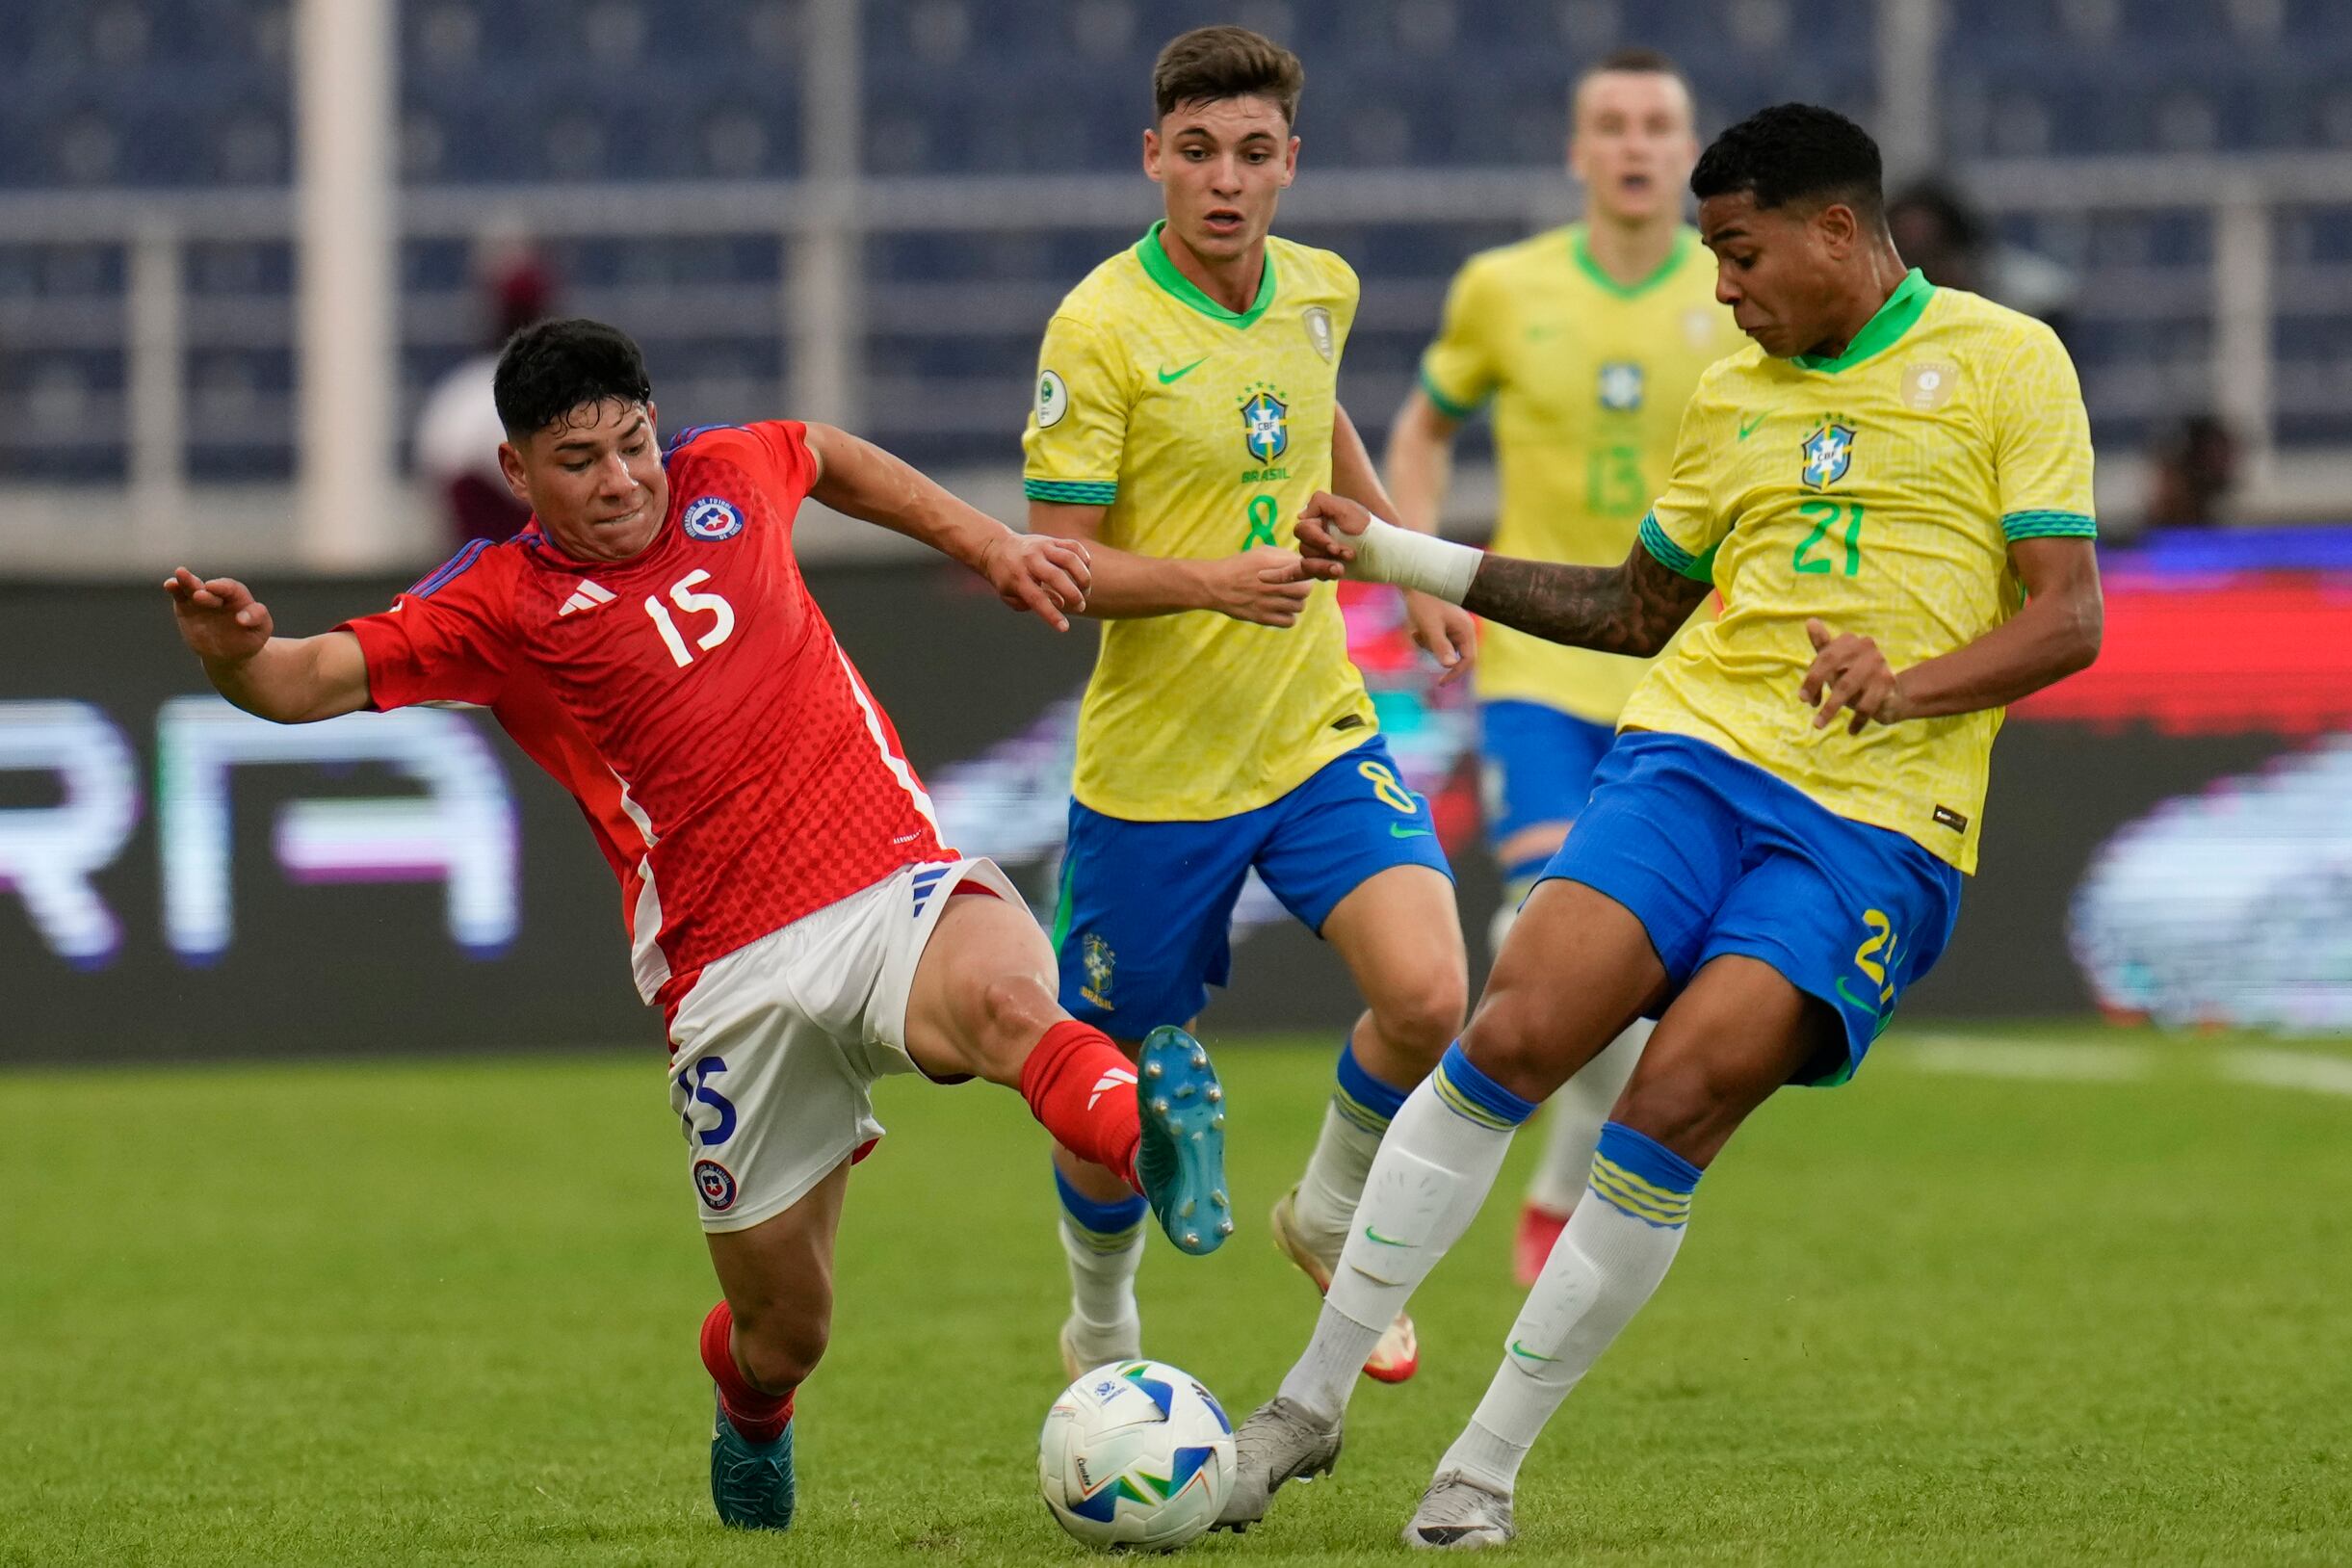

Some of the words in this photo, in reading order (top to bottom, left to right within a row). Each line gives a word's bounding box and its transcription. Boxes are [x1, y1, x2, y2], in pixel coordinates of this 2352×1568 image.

[1241, 467, 1291, 483] BRASIL
[1241, 494, 1278, 553] 8
[1793, 501, 1865, 577] 21
[644, 568, 736, 668] 15
[1357, 760, 1418, 815] 8
